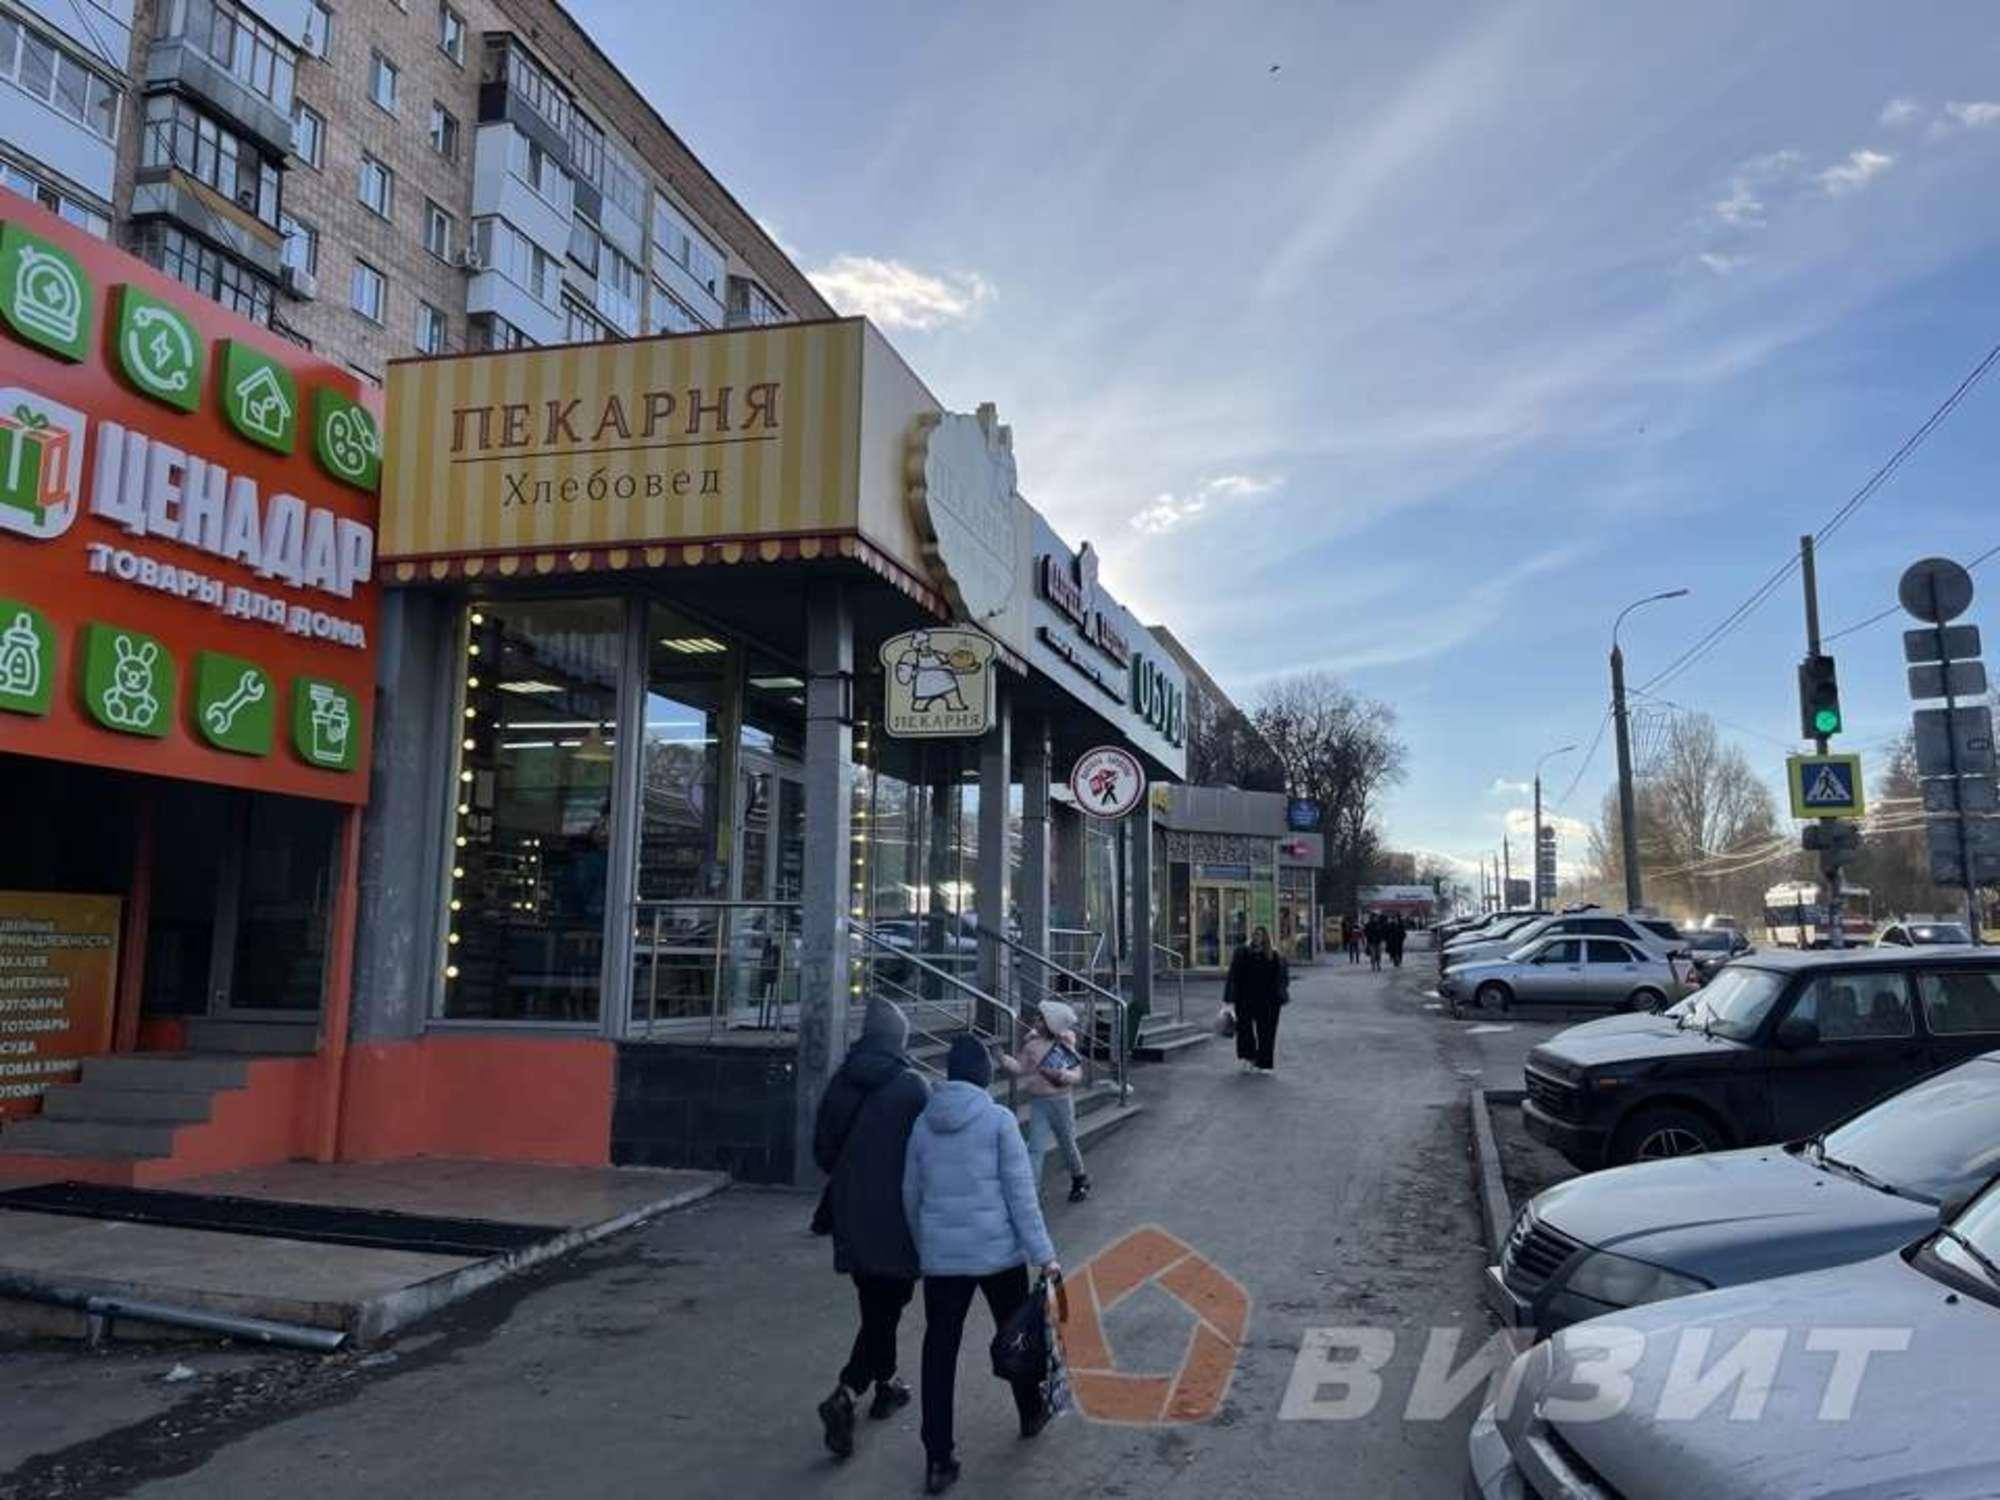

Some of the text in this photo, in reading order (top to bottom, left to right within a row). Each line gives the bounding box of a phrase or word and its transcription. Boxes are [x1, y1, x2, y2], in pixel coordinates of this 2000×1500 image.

[450, 382, 780, 453] ПЕКАРНЯ
[91, 420, 374, 599] ЦЕНАДАР
[503, 467, 722, 507] Хлебовед
[86, 541, 367, 649] ТОВАРЫ ДЛЯ ДОМА
[895, 714, 980, 729] ПЕКАРНЯ
